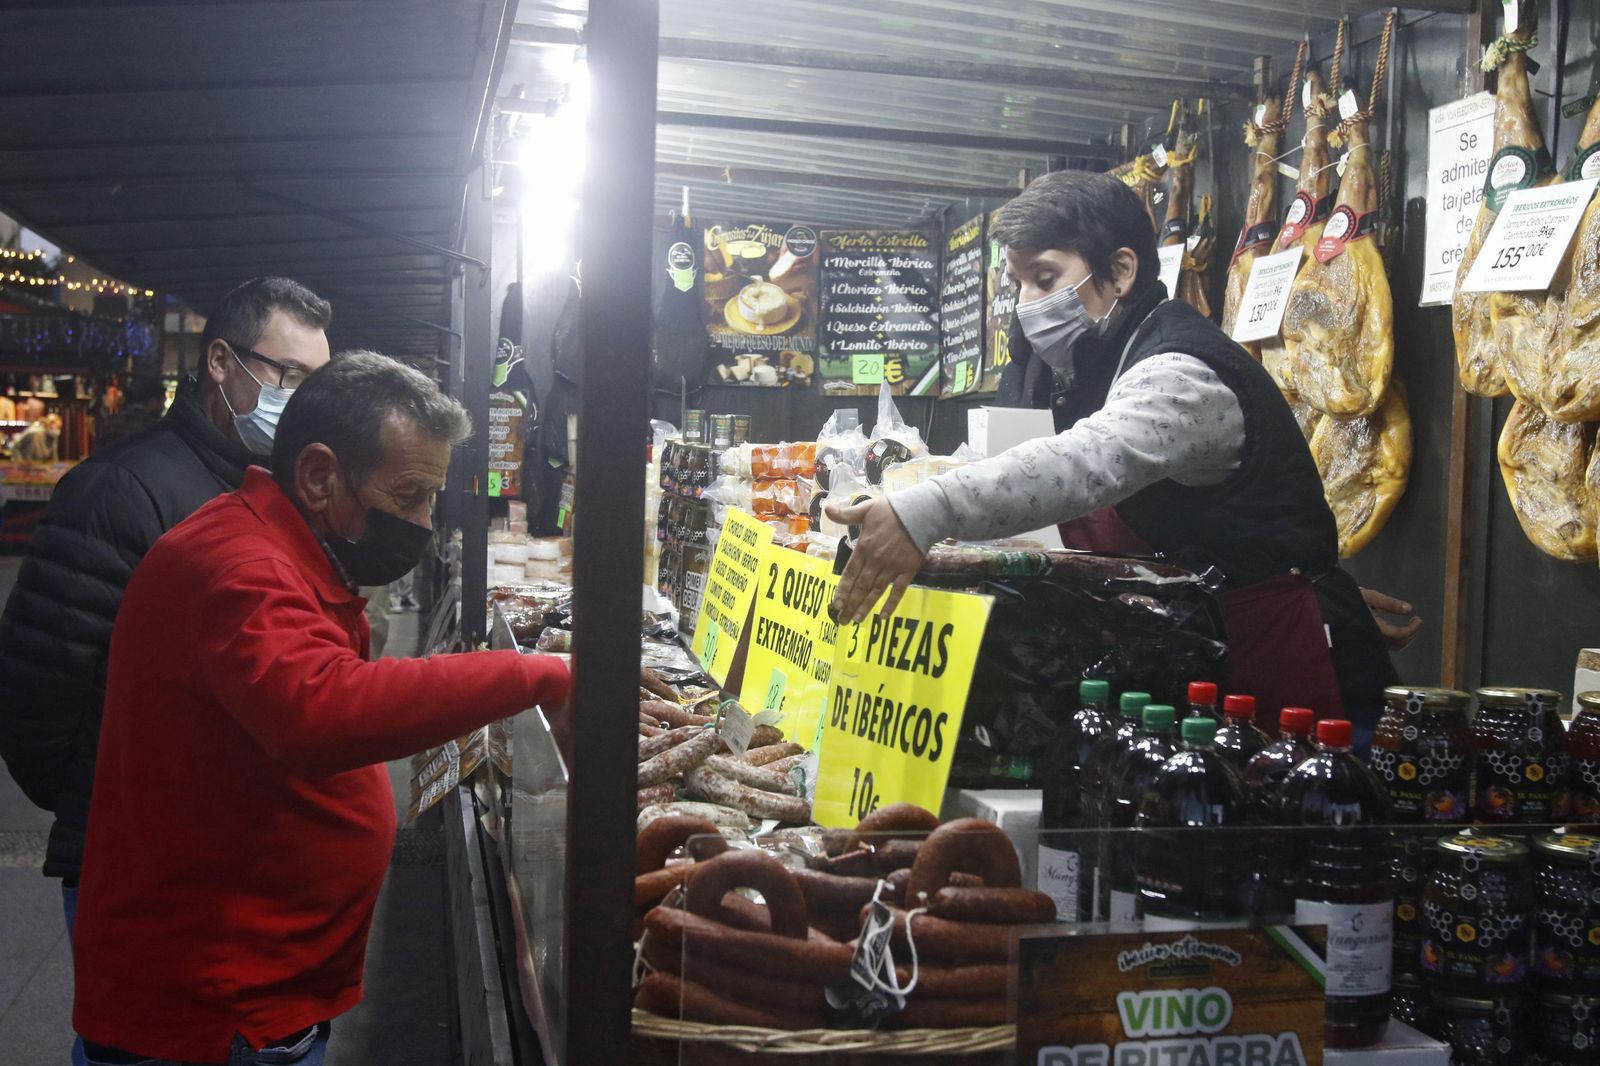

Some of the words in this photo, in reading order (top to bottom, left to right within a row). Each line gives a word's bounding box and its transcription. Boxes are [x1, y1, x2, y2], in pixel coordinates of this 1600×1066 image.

[1460, 132, 1478, 152] Se
[1456, 215, 1473, 234] de
[748, 223, 785, 249] Zújar
[829, 234, 873, 250] Oferta
[876, 234, 929, 248] Estrella
[824, 257, 829, 268] 1
[830, 256, 887, 270] Morcilla
[888, 256, 935, 269] Ibérica
[1441, 243, 1464, 265] cré
[831, 283, 837, 294] 1
[836, 283, 883, 295] Chorizo
[884, 282, 929, 296] Ibérico
[829, 303, 834, 313] 1
[834, 303, 890, 314] Salchichón
[891, 302, 931, 313] Ibérico
[826, 321, 832, 332] 1
[833, 320, 868, 335] Queso
[869, 320, 934, 332] Extremeño
[831, 340, 836, 351] 1
[837, 339, 883, 351] Lomito
[883, 339, 929, 351] Ibérico
[858, 359, 880, 376] 20
[715, 559, 728, 579] QUESO
[766, 562, 779, 600] 2
[782, 567, 826, 619] QUESO
[822, 622, 838, 646] SALCH
[847, 621, 860, 658] 3
[866, 613, 954, 679] PIEZAS
[814, 658, 832, 685] QUESO
[831, 685, 853, 731] DE
[852, 684, 948, 762] IBÉRICOS
[1120, 990, 1229, 1034] VINO
